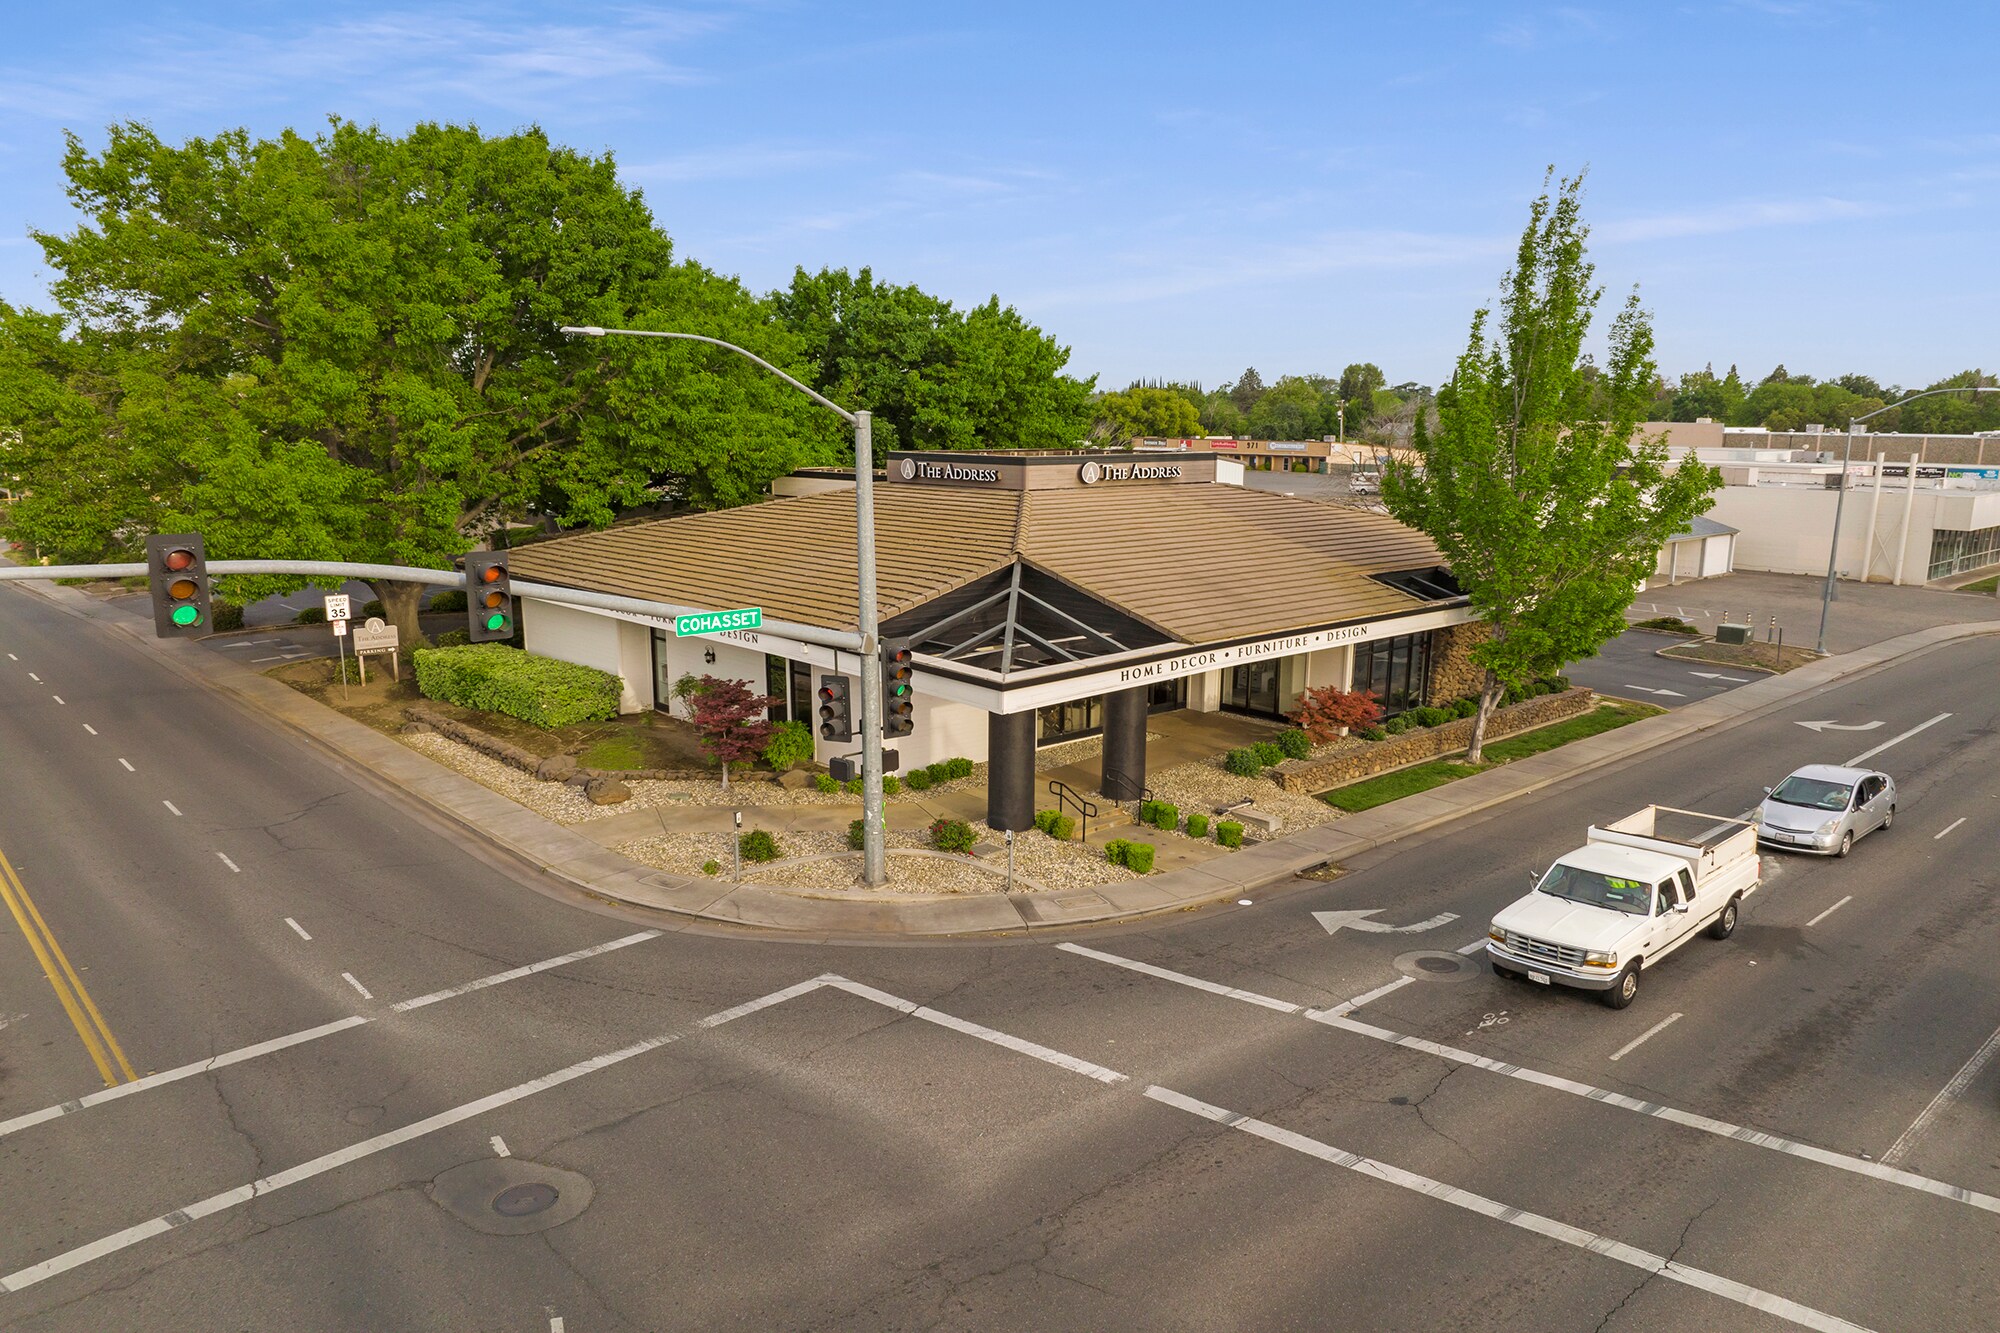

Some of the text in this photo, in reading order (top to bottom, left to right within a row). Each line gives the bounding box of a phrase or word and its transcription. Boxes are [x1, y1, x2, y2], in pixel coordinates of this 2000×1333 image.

[917, 462, 941, 478] THE
[943, 463, 997, 482] ADDRESS
[1102, 464, 1128, 480] THE
[1131, 463, 1182, 479] ADDRESS
[331, 608, 346, 618] 35
[680, 611, 758, 633] COHASSET
[1121, 626, 1368, 682] HOME DECOR FURNITURE DESIGN
